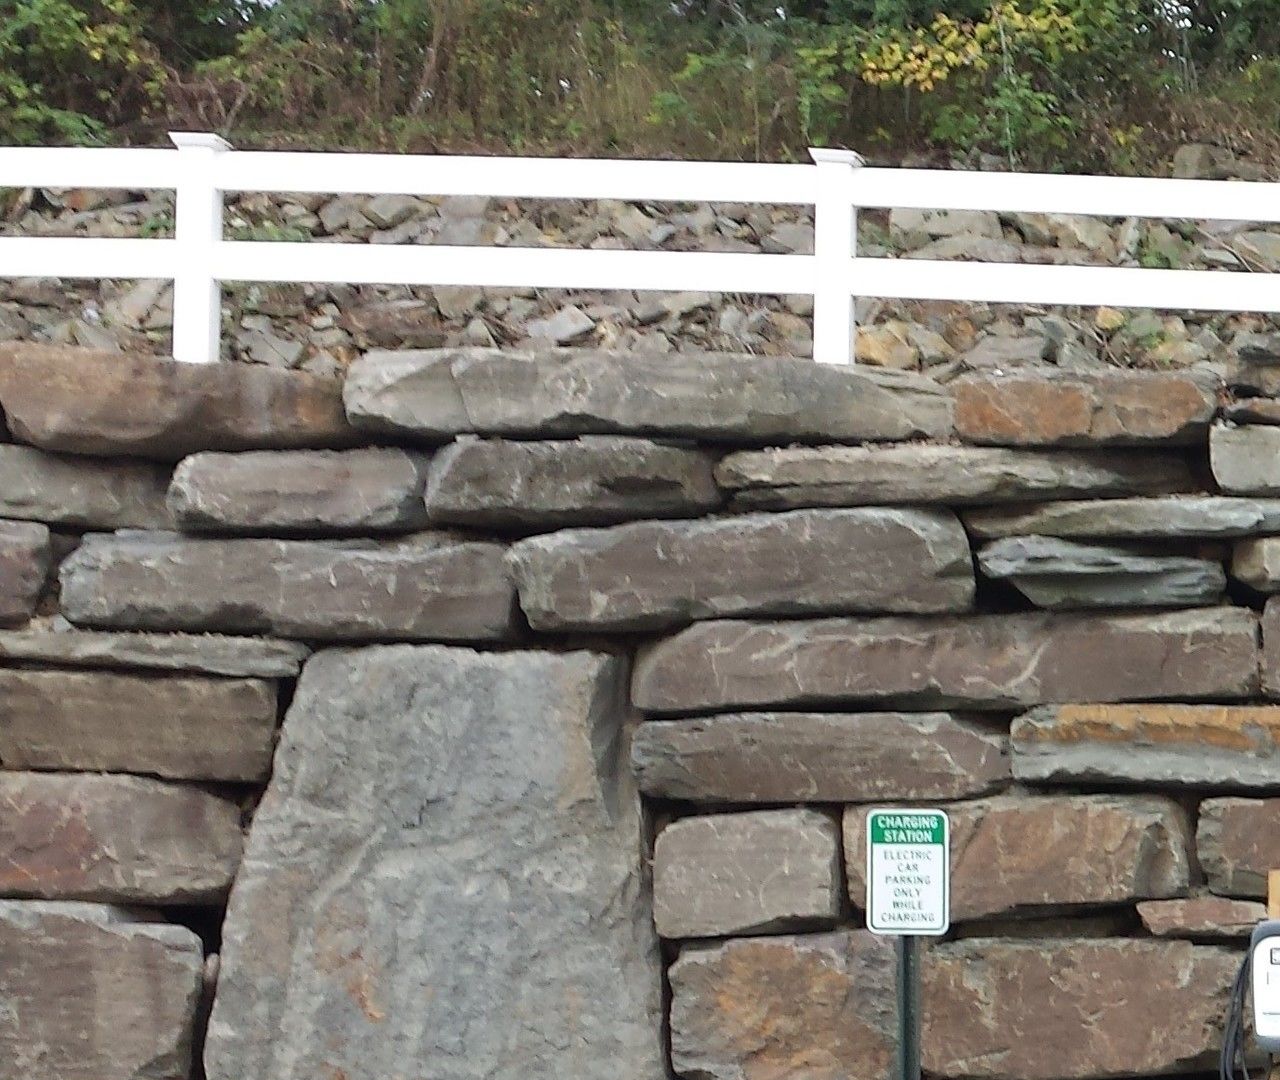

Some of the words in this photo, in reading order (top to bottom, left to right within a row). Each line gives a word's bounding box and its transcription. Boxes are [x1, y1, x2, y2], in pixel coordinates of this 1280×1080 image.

[877, 815, 939, 829] CHARGING
[884, 829, 933, 842] STATION
[883, 850, 932, 860] ELECTRIC
[897, 863, 919, 872] CAR
[885, 875, 931, 885] PARKING
[893, 888, 922, 898] ONLY
[892, 901, 922, 910] WHILE
[881, 913, 935, 922] CHARGING
